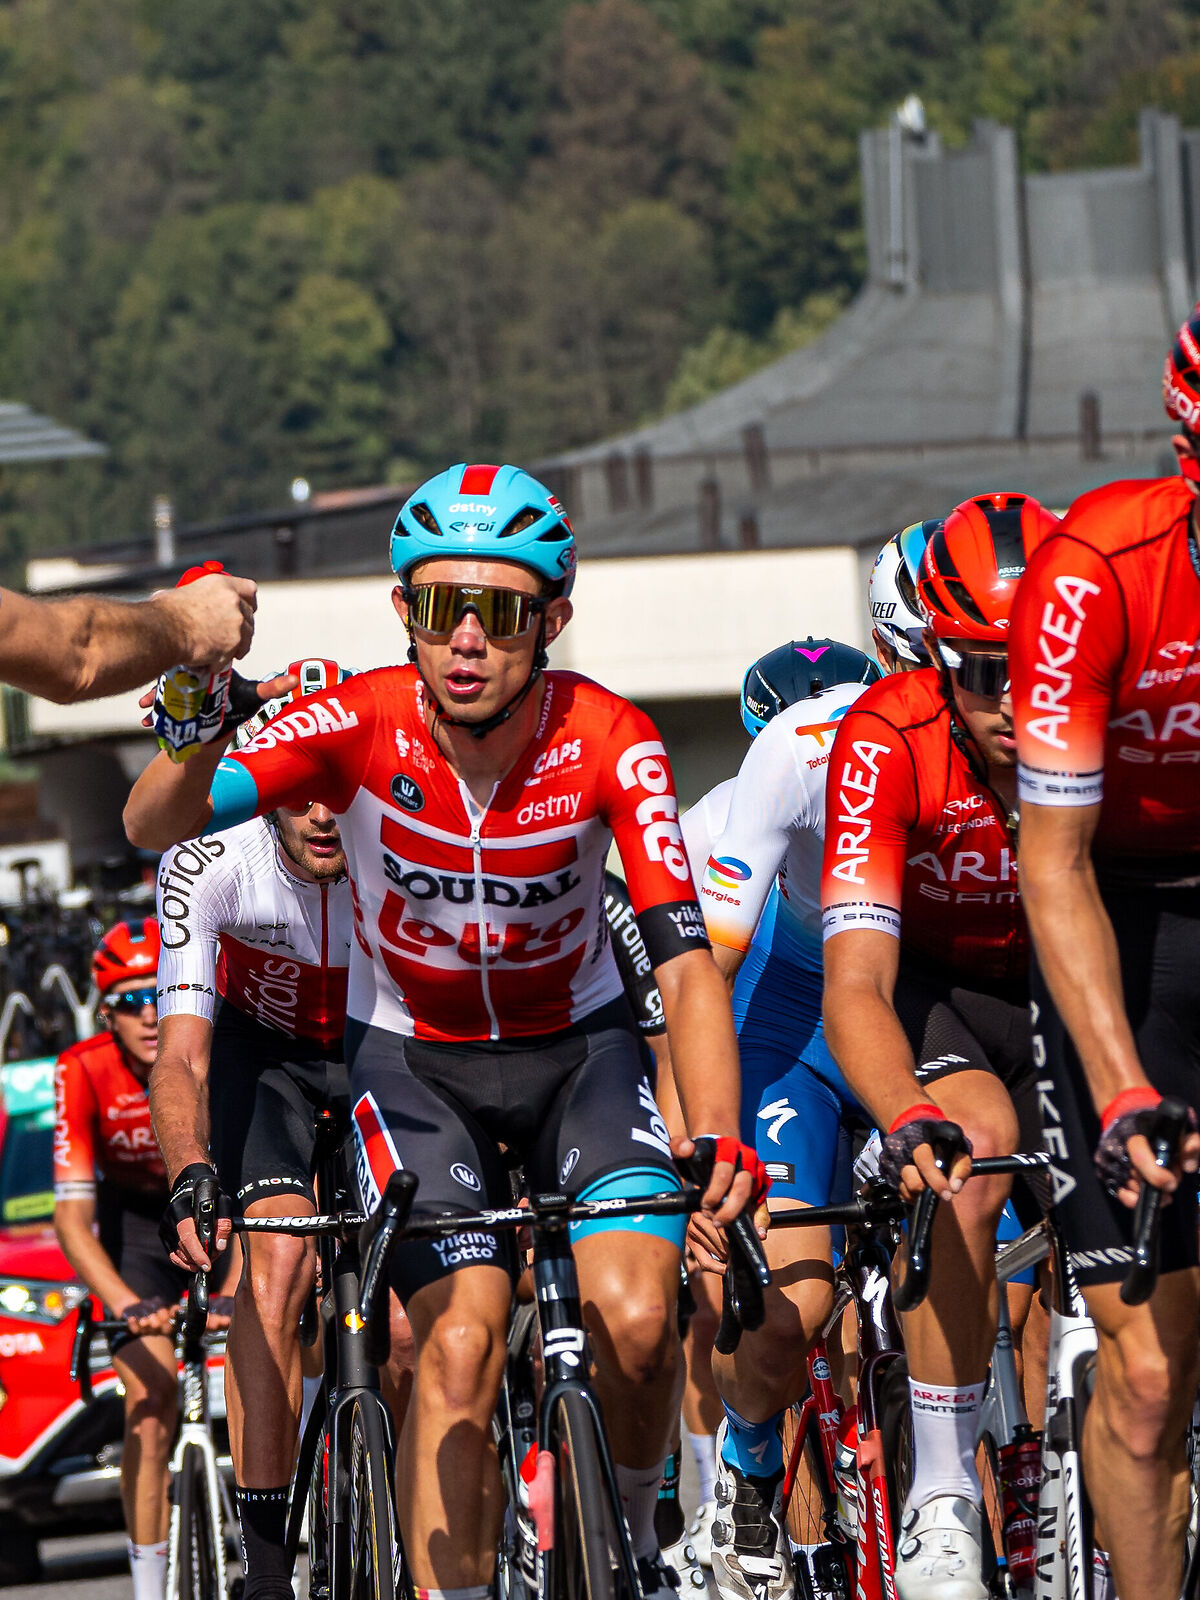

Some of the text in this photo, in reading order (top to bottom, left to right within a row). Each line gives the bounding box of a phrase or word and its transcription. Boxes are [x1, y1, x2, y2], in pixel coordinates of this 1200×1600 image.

[448, 502, 497, 517] dstny
[872, 602, 897, 618] IZED
[1026, 575, 1101, 750] ARKEA
[240, 697, 360, 754] SOUDAL
[535, 681, 554, 740] SOUDAL
[533, 738, 582, 774] CAPS
[516, 791, 583, 825] dstny
[615, 740, 690, 882] lotto
[831, 740, 892, 885] ARKEA
[382, 853, 582, 909] SOUDAL
[906, 847, 1019, 882] ARK
[159, 833, 226, 950] cofidis
[701, 884, 742, 907] nergies
[377, 888, 586, 966] lotto
[167, 983, 214, 997] ROSA
[236, 1177, 305, 1200] DE ROSA
[431, 1231, 499, 1252] viking
[440, 1245, 494, 1267] lotto
[912, 1388, 977, 1404] ARKEA
[843, 1517, 858, 1529] GAR
